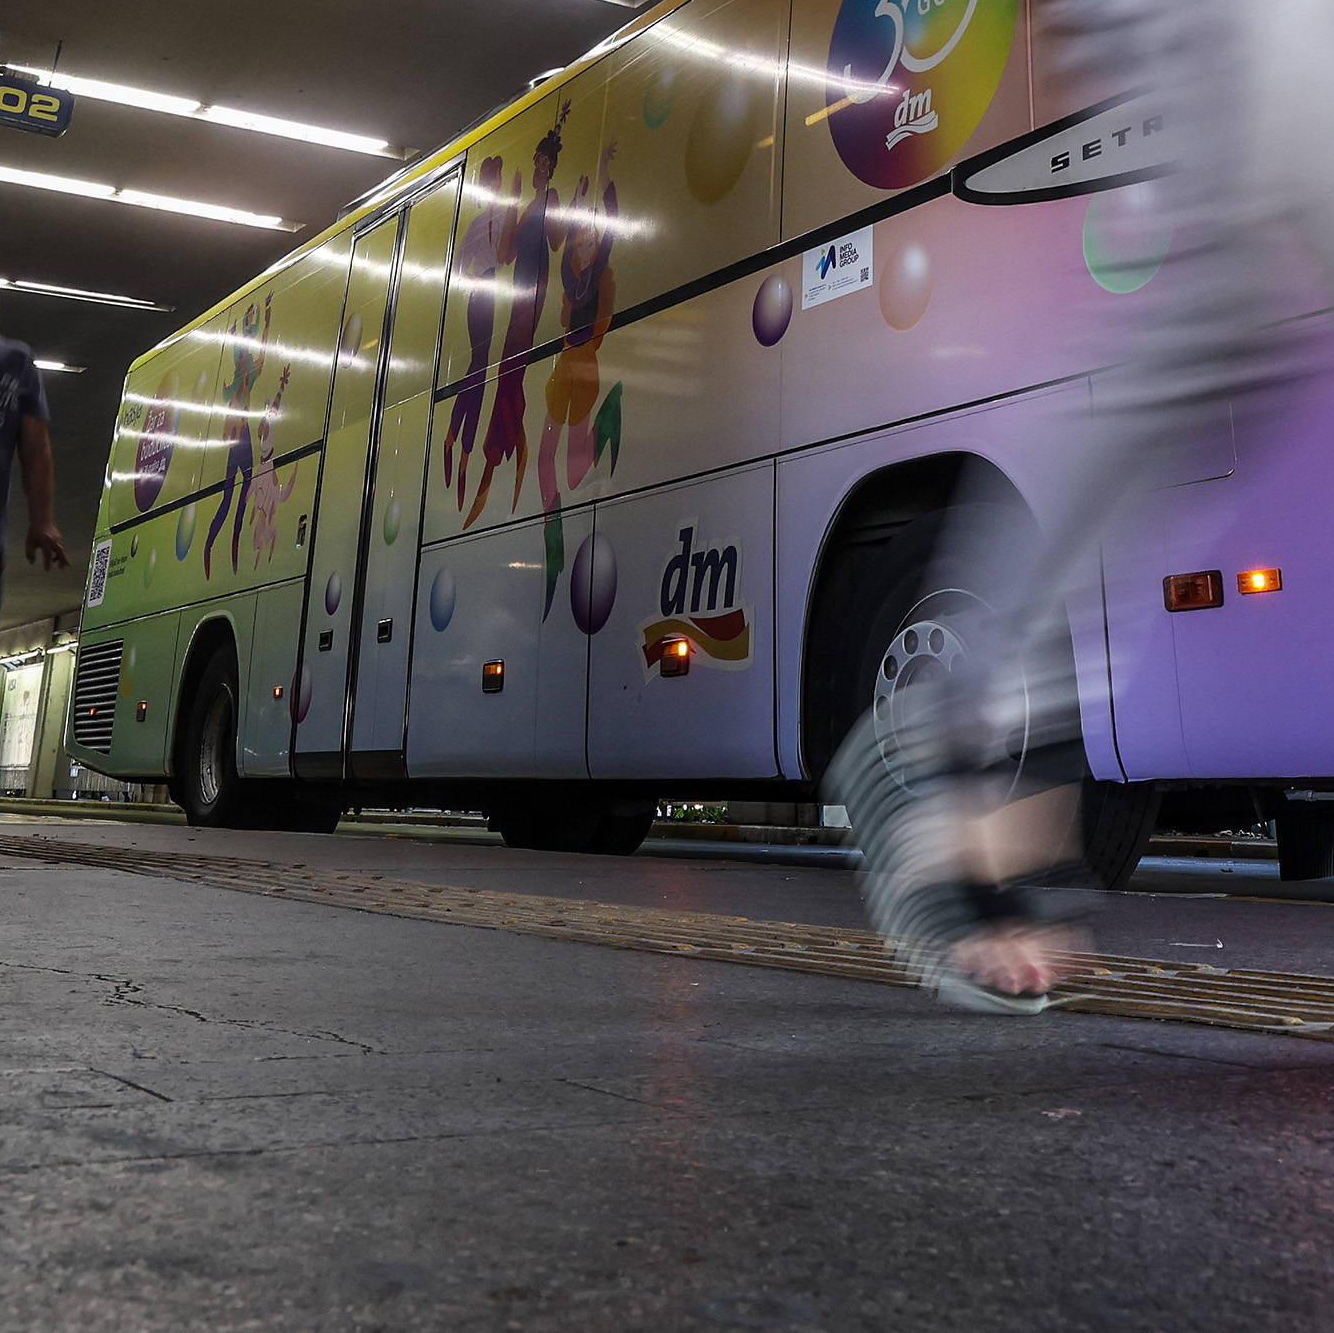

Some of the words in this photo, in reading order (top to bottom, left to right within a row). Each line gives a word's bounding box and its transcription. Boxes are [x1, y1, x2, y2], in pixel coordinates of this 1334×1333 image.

[894, 88, 932, 128] dm
[1050, 115, 1165, 174] SETR
[839, 242, 853, 254] INFO
[839, 248, 858, 261] MEDIA
[839, 254, 860, 268] GROUP
[660, 526, 738, 617] dm
